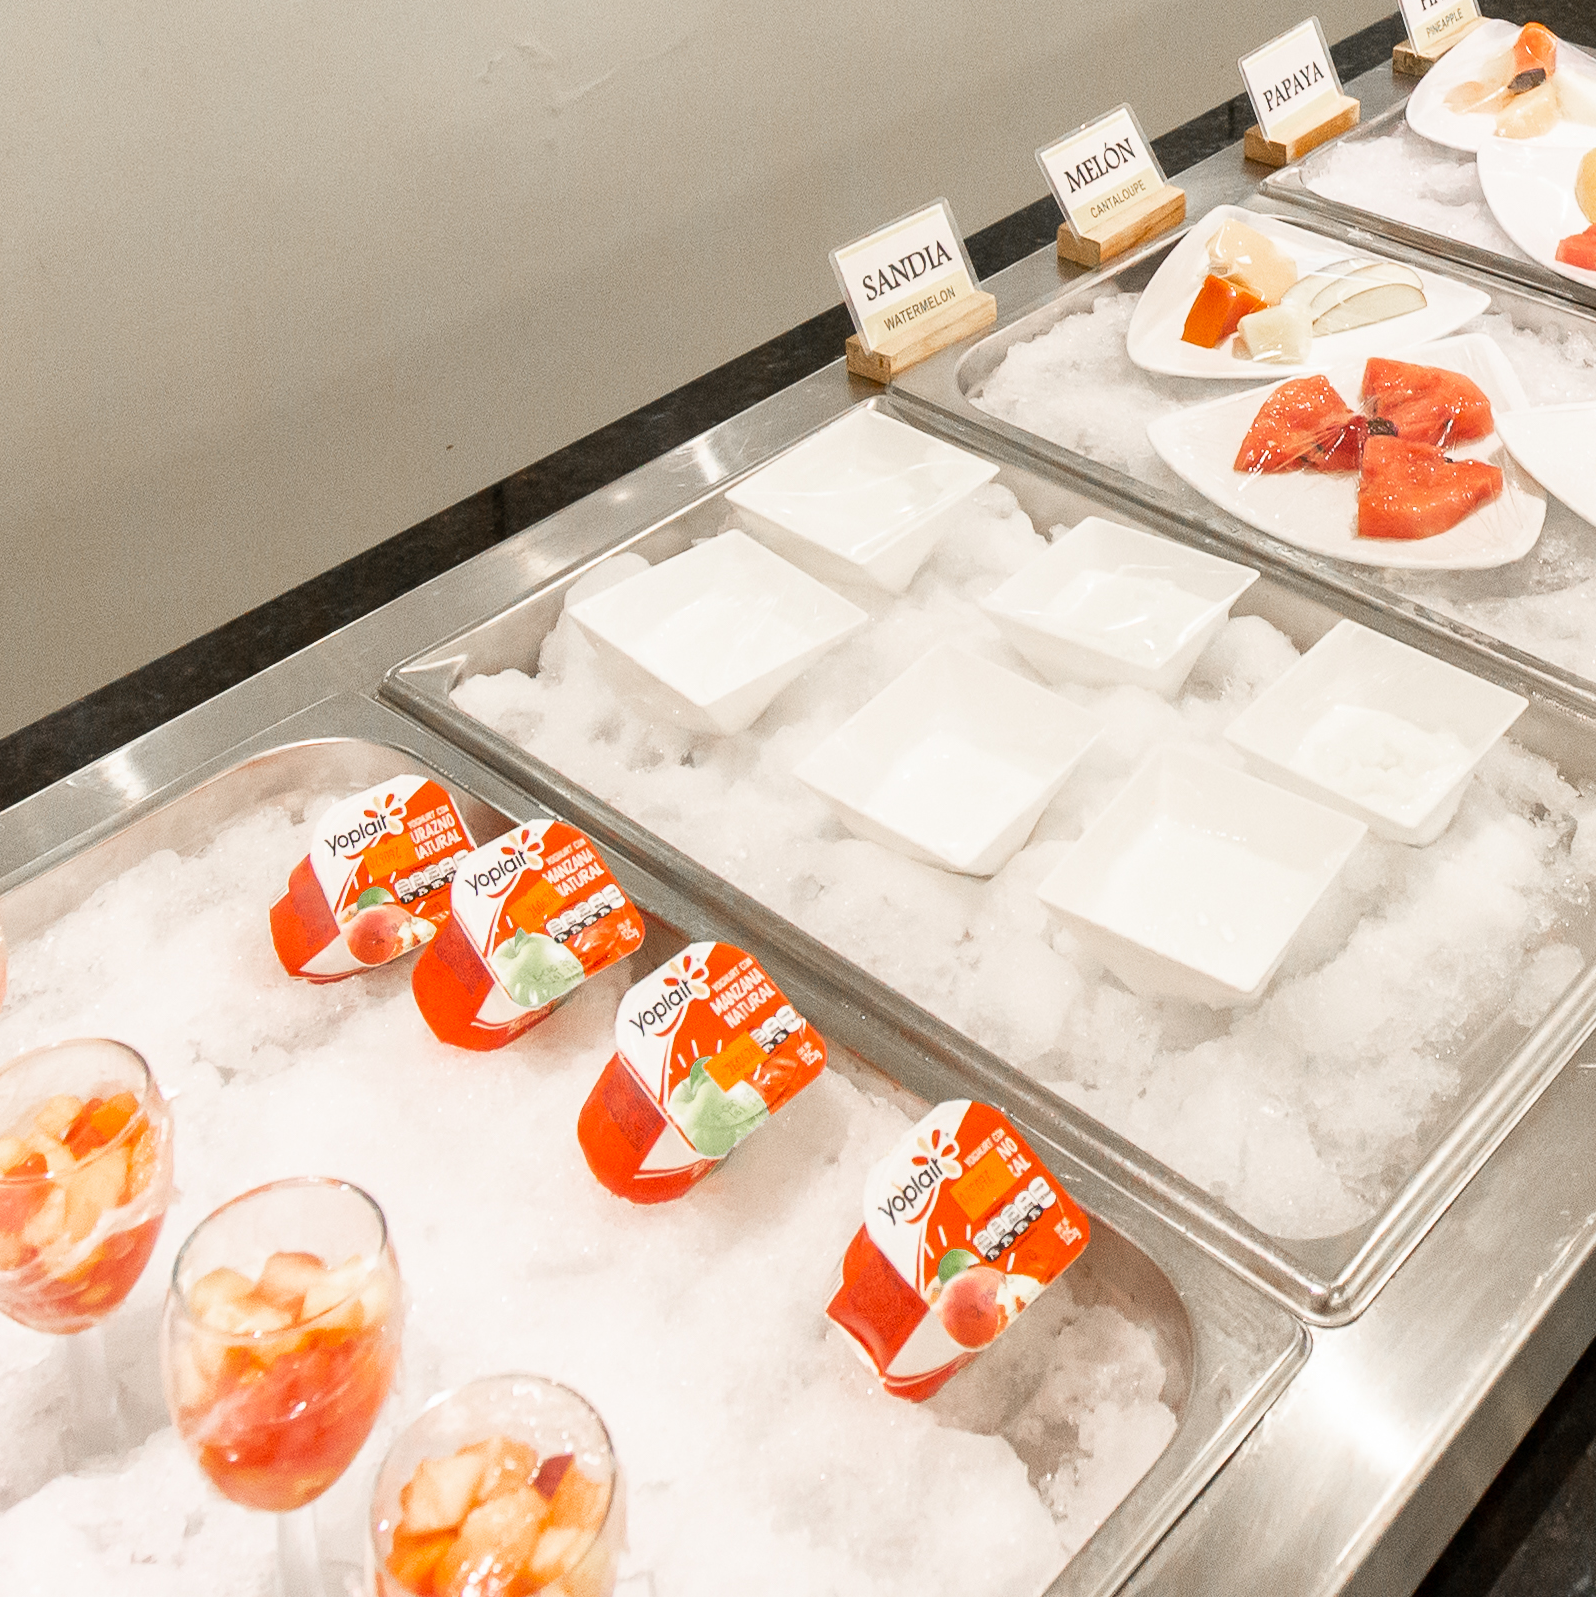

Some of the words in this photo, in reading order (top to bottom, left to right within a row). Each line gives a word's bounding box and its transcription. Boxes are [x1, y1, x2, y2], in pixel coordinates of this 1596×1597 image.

[1426, 7, 1463, 38] PINEAPPLE
[1263, 61, 1325, 112] PAPAYA
[1064, 137, 1136, 193] MELÓN
[1090, 179, 1146, 218] CANTALOUPE
[863, 240, 952, 301] SANDIA
[884, 285, 956, 331] WATERMELON
[409, 813, 456, 844] URAZNO
[541, 848, 596, 884] MANZANA
[709, 968, 765, 1016] MANZANA
[723, 983, 776, 1029] NATURAL
